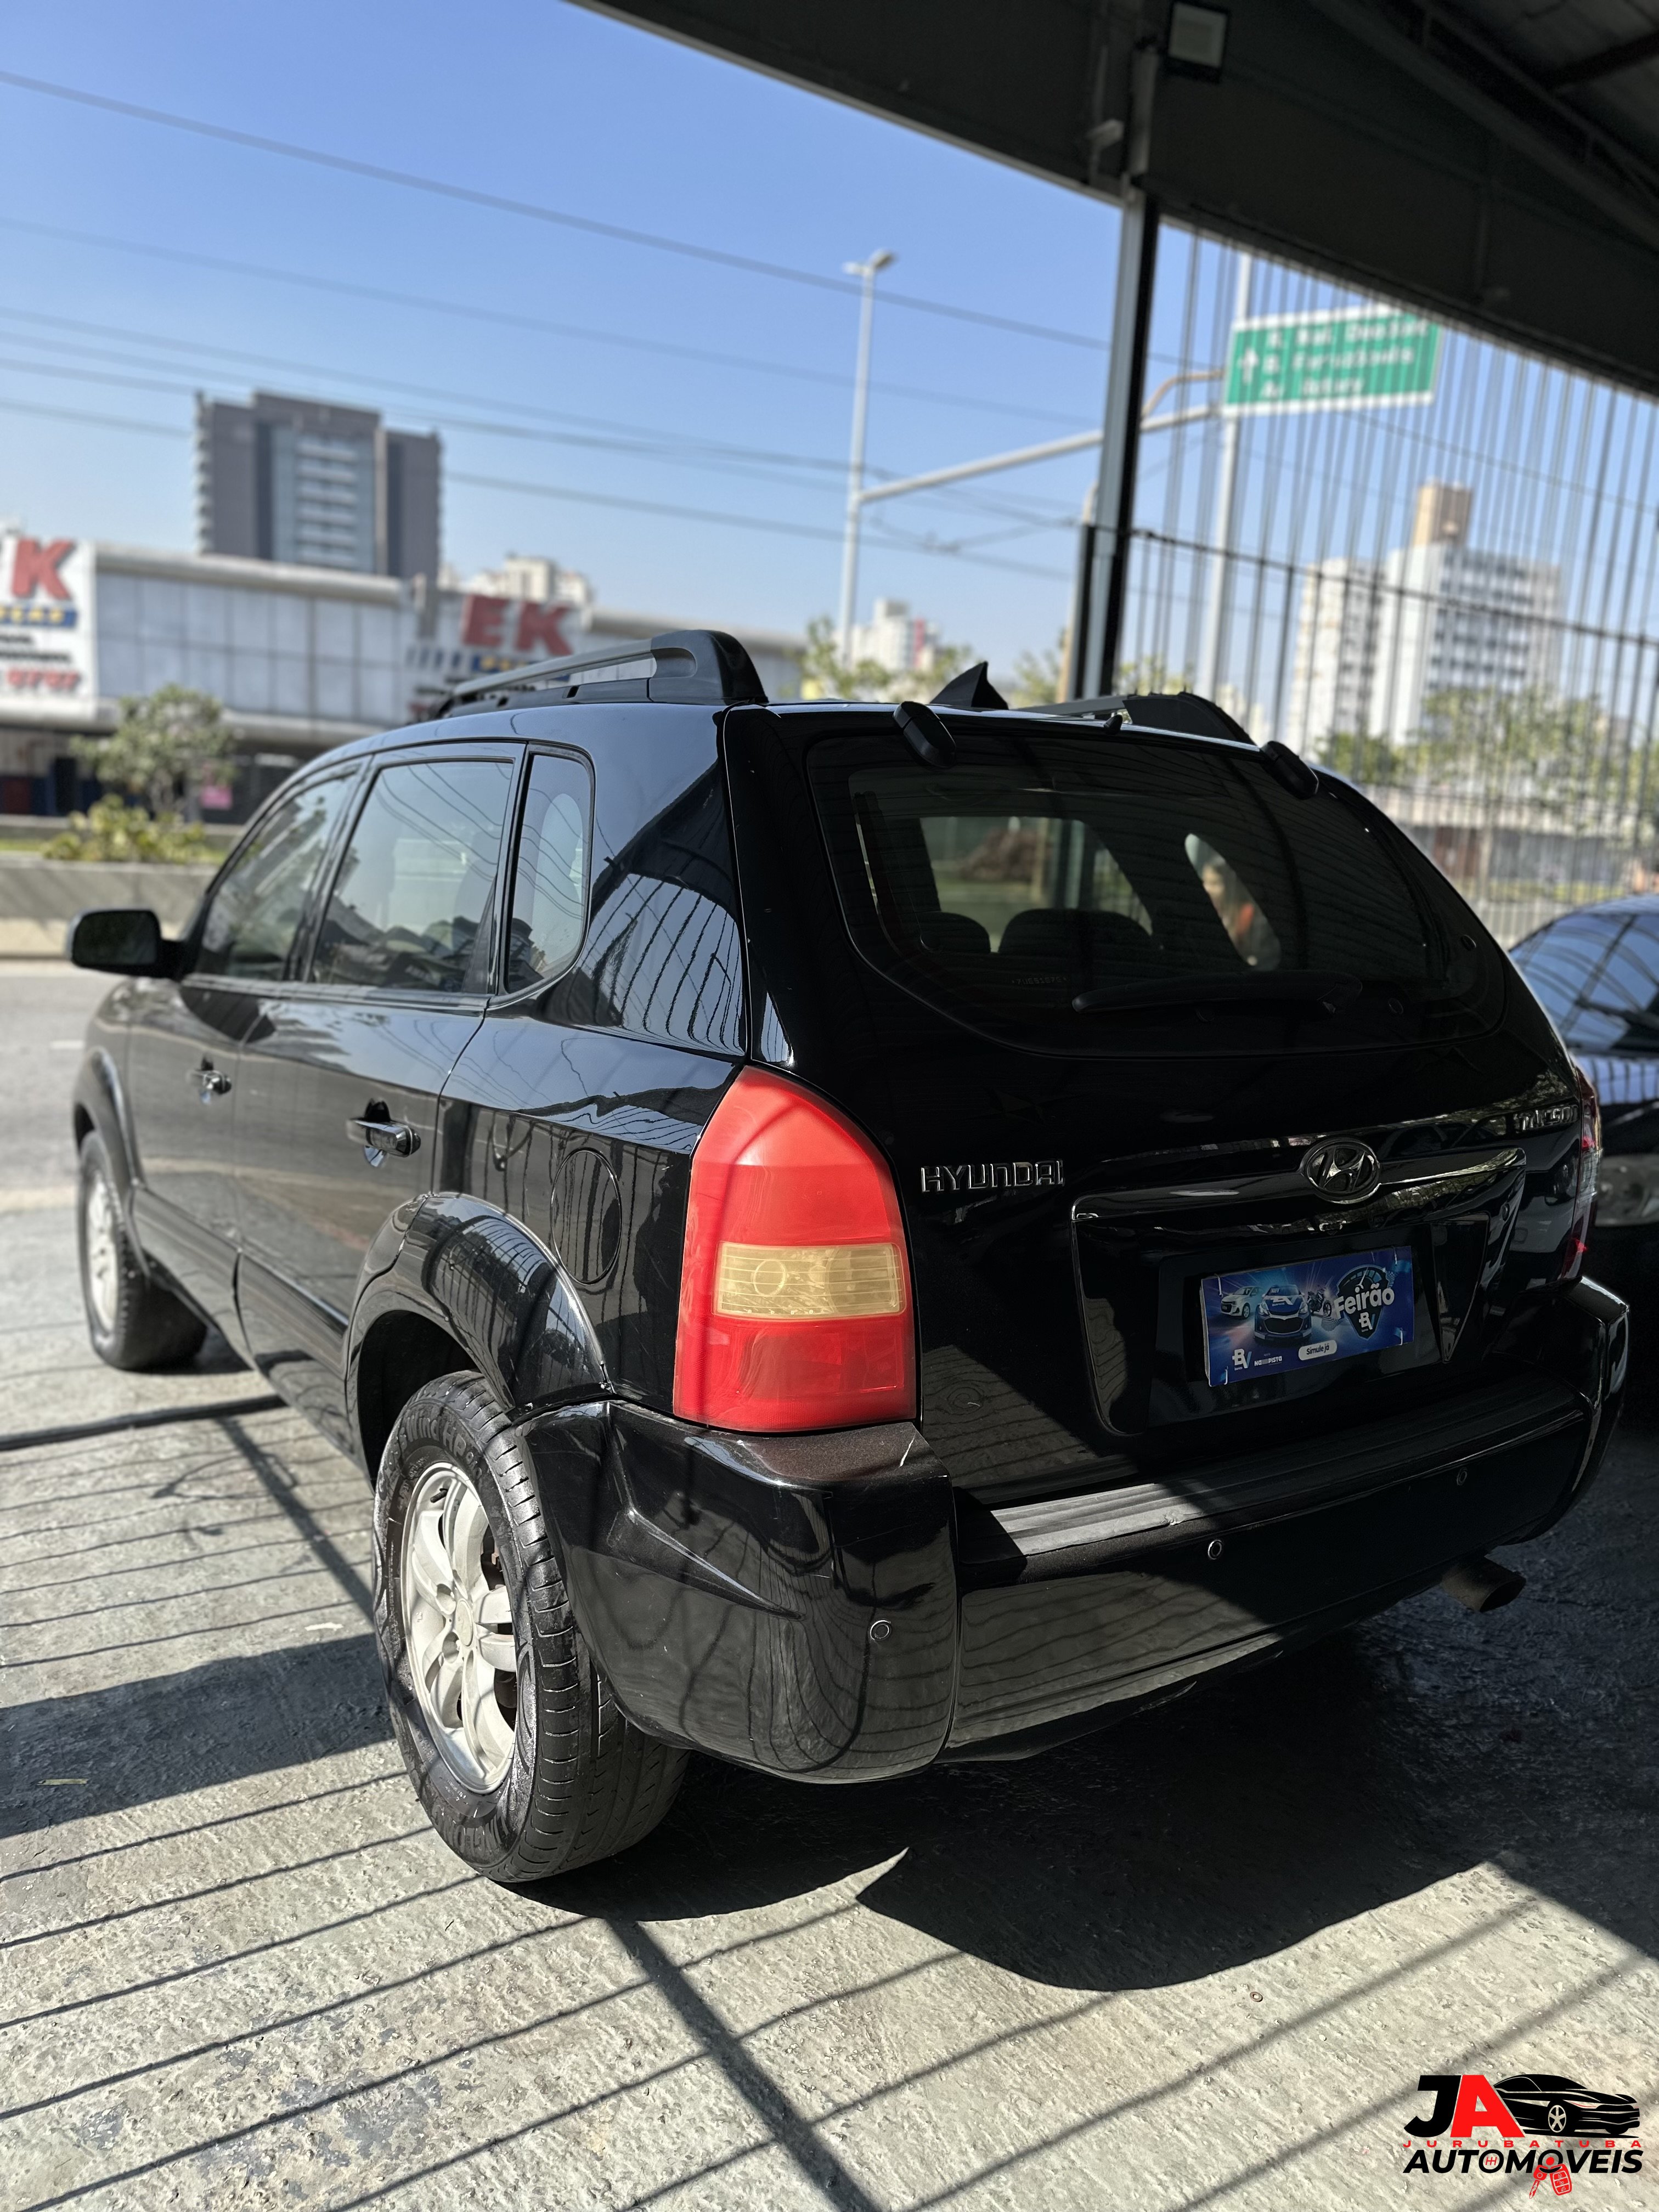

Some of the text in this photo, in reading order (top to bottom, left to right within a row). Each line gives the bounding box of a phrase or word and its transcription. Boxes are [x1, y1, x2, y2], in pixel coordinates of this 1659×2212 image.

[10, 538, 77, 602] K
[461, 594, 574, 657] EK
[921, 1159, 1065, 1192] HYUNDAI
[1334, 1283, 1395, 1319] Feirão
[1306, 1342, 1330, 1355] Simule já
